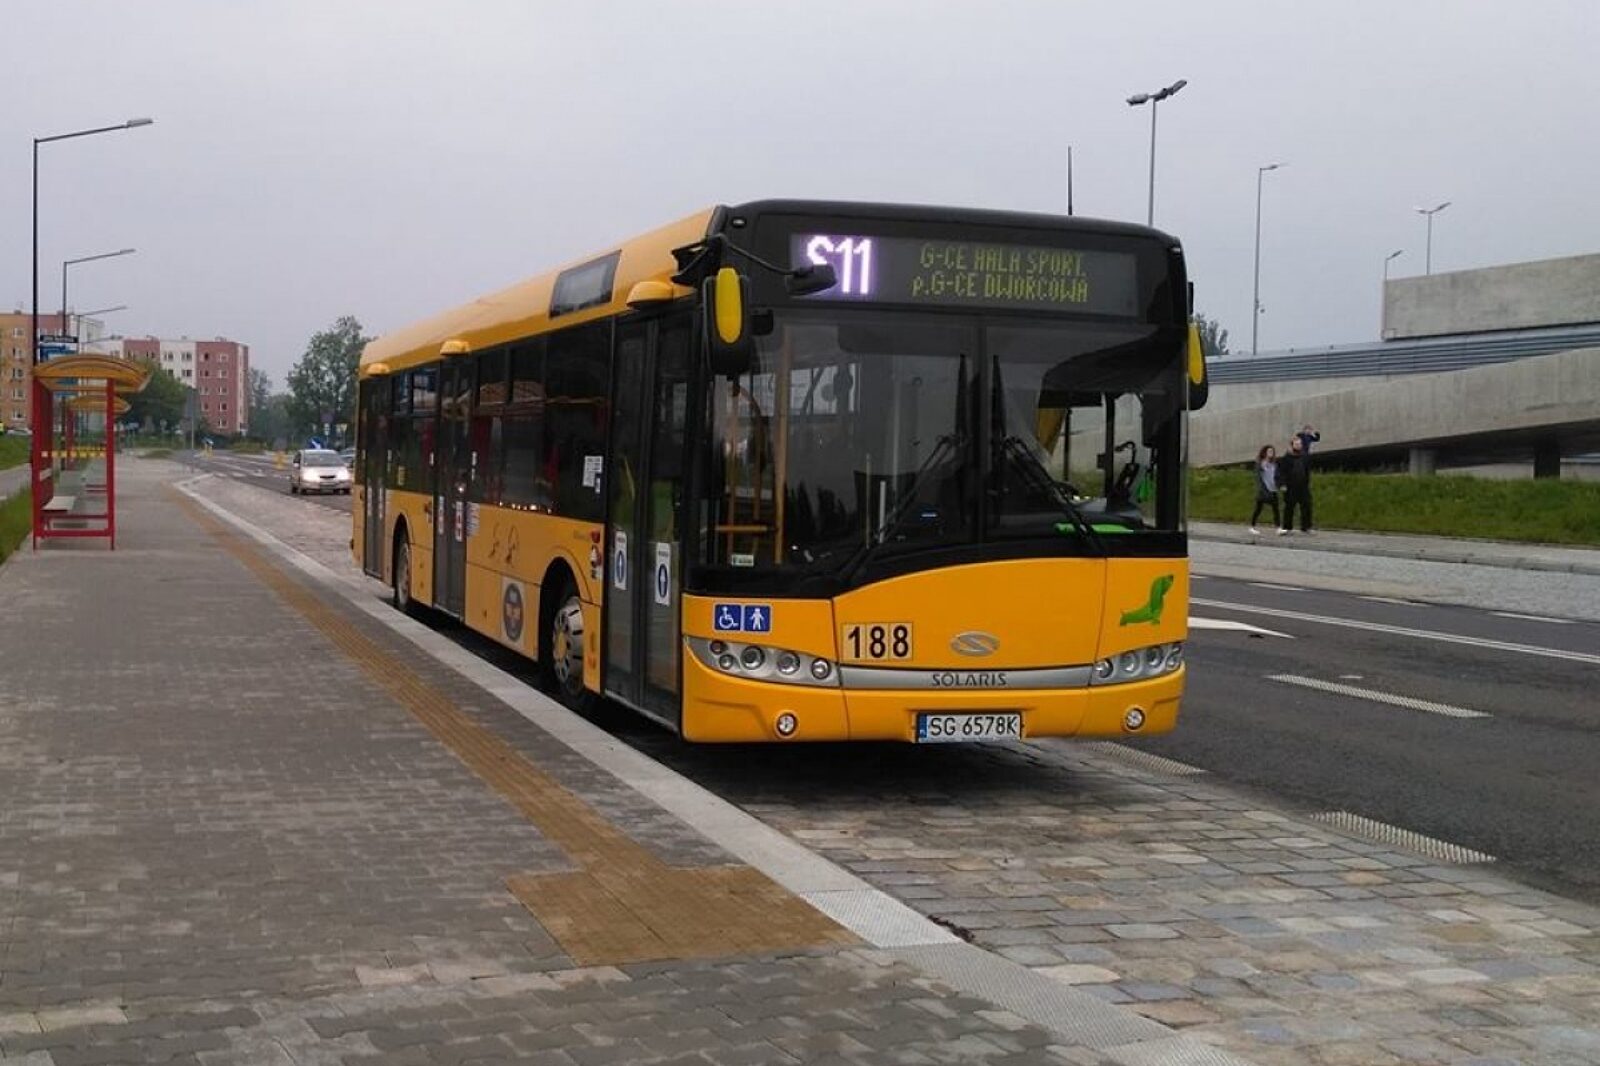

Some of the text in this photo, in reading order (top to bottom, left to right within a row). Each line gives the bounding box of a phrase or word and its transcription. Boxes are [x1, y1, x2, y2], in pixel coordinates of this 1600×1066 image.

[920, 244, 967, 270] G-CE
[974, 248, 1021, 273] HALA
[984, 273, 1088, 302] DWORCOWA
[848, 625, 909, 659] 188
[932, 672, 1007, 687] SOLARIS
[930, 715, 1018, 736] SG 6578K
